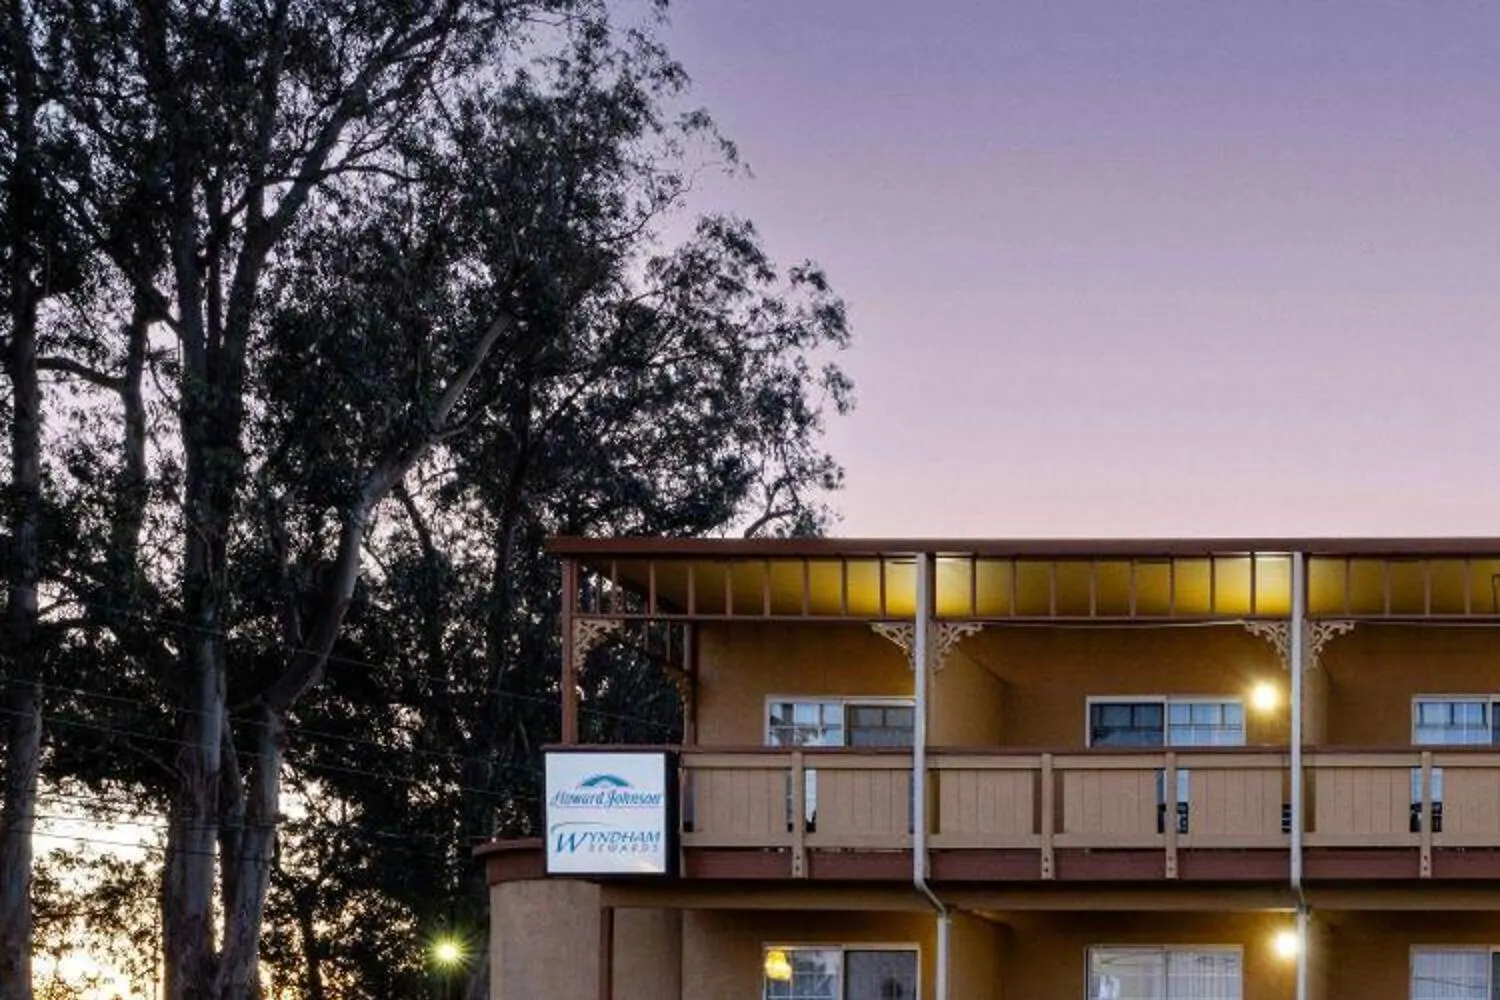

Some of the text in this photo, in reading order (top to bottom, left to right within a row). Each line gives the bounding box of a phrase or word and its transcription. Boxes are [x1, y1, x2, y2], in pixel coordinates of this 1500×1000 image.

[550, 789, 662, 808] Howard Johnson
[556, 831, 661, 853] WYNDHAM
